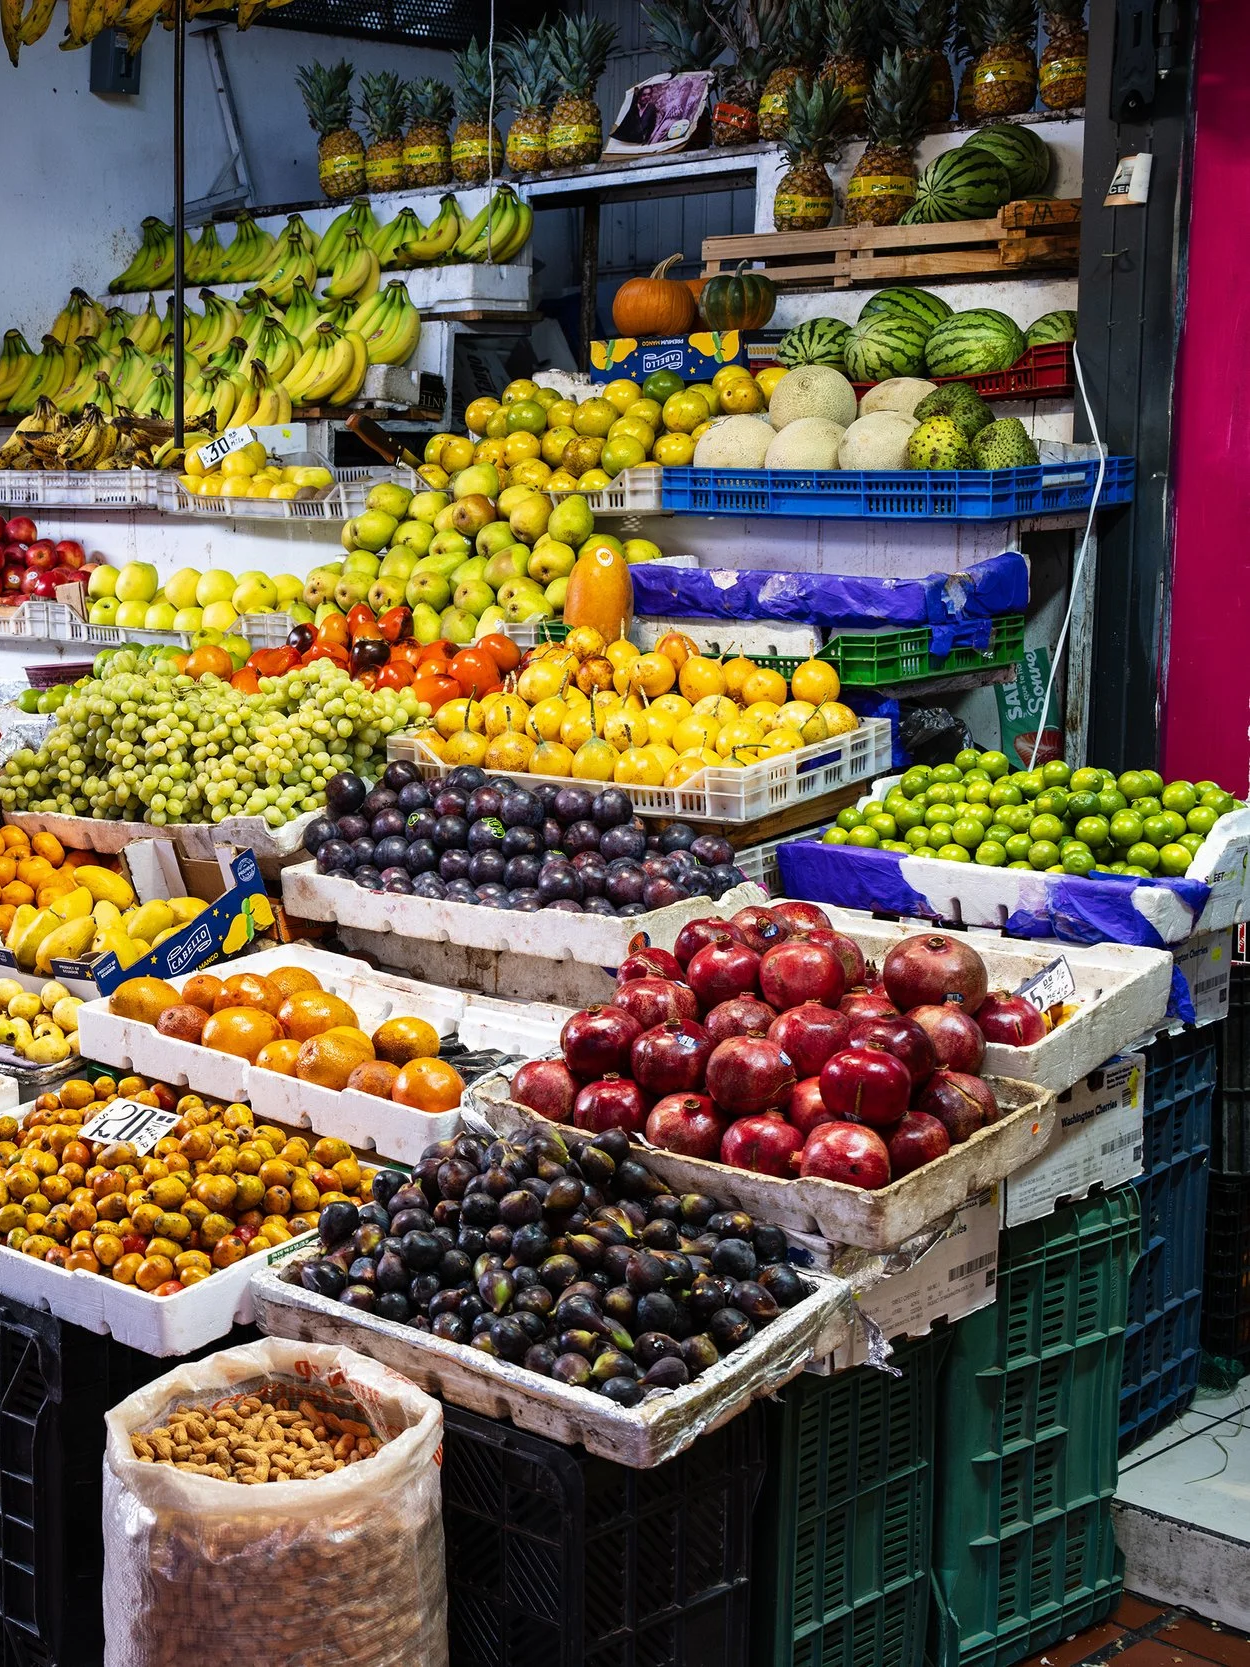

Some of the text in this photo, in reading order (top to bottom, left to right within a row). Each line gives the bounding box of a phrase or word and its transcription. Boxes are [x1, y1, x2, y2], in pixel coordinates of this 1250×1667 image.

[646, 353, 681, 369] CABELLO
[170, 929, 208, 970] CABELLO
[198, 952, 220, 971] MANGO
[1061, 1100, 1118, 1128] Washington Cherries
